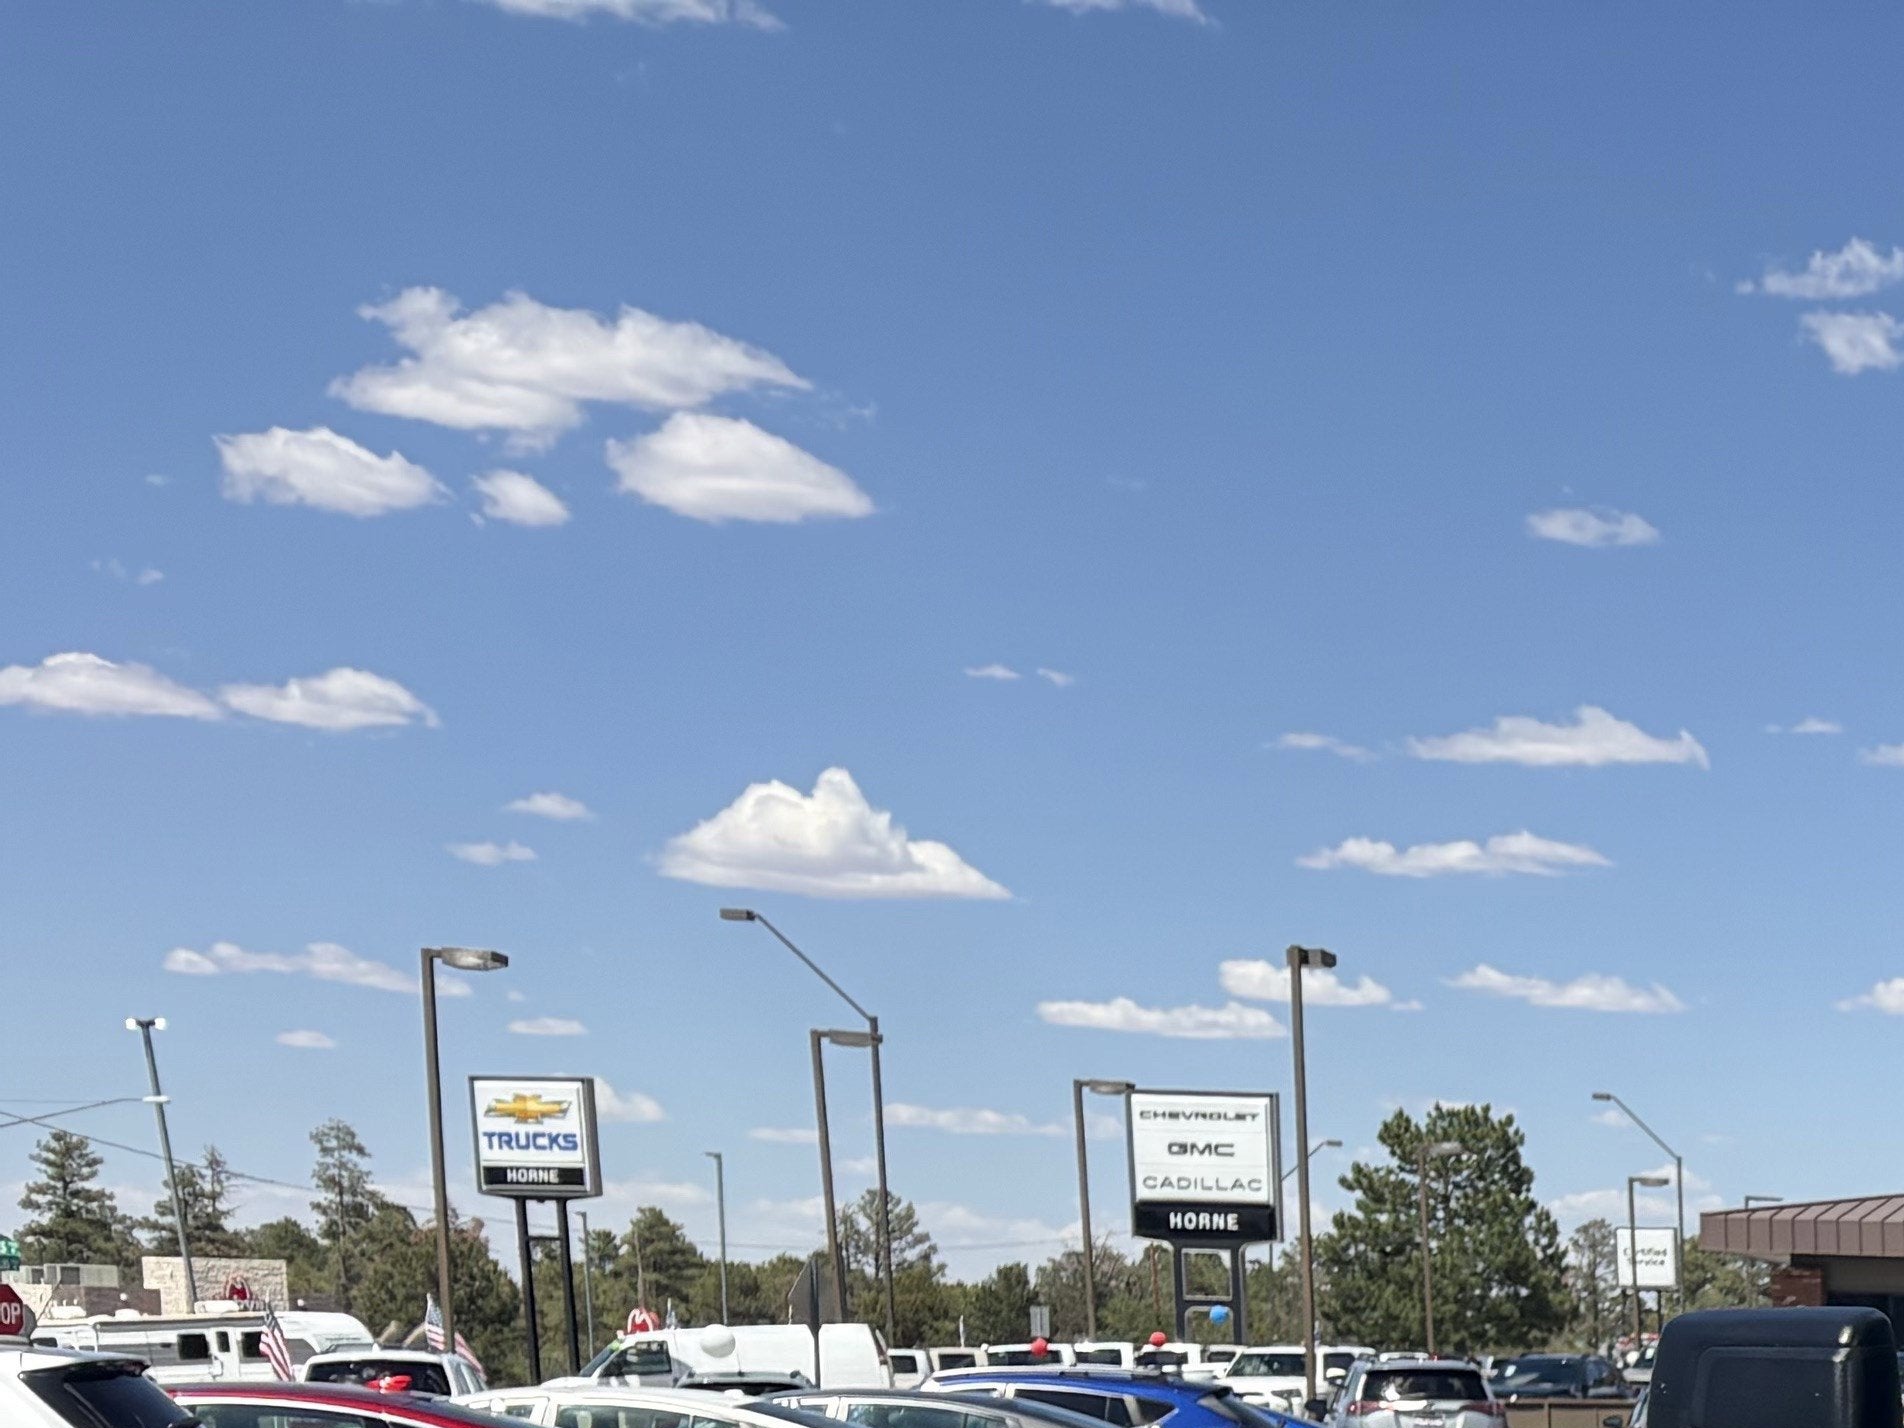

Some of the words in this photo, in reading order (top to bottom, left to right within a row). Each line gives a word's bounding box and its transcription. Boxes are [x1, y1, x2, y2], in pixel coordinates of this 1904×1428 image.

[1139, 1110, 1260, 1122] CHEVROLET
[482, 1131, 579, 1151] TRUCKS
[1167, 1141, 1235, 1157] GMC
[506, 1168, 560, 1184] HORNE
[1142, 1175, 1263, 1192] CADILLAC
[1168, 1211, 1239, 1231] HORNE
[0, 1302, 21, 1325] OP
